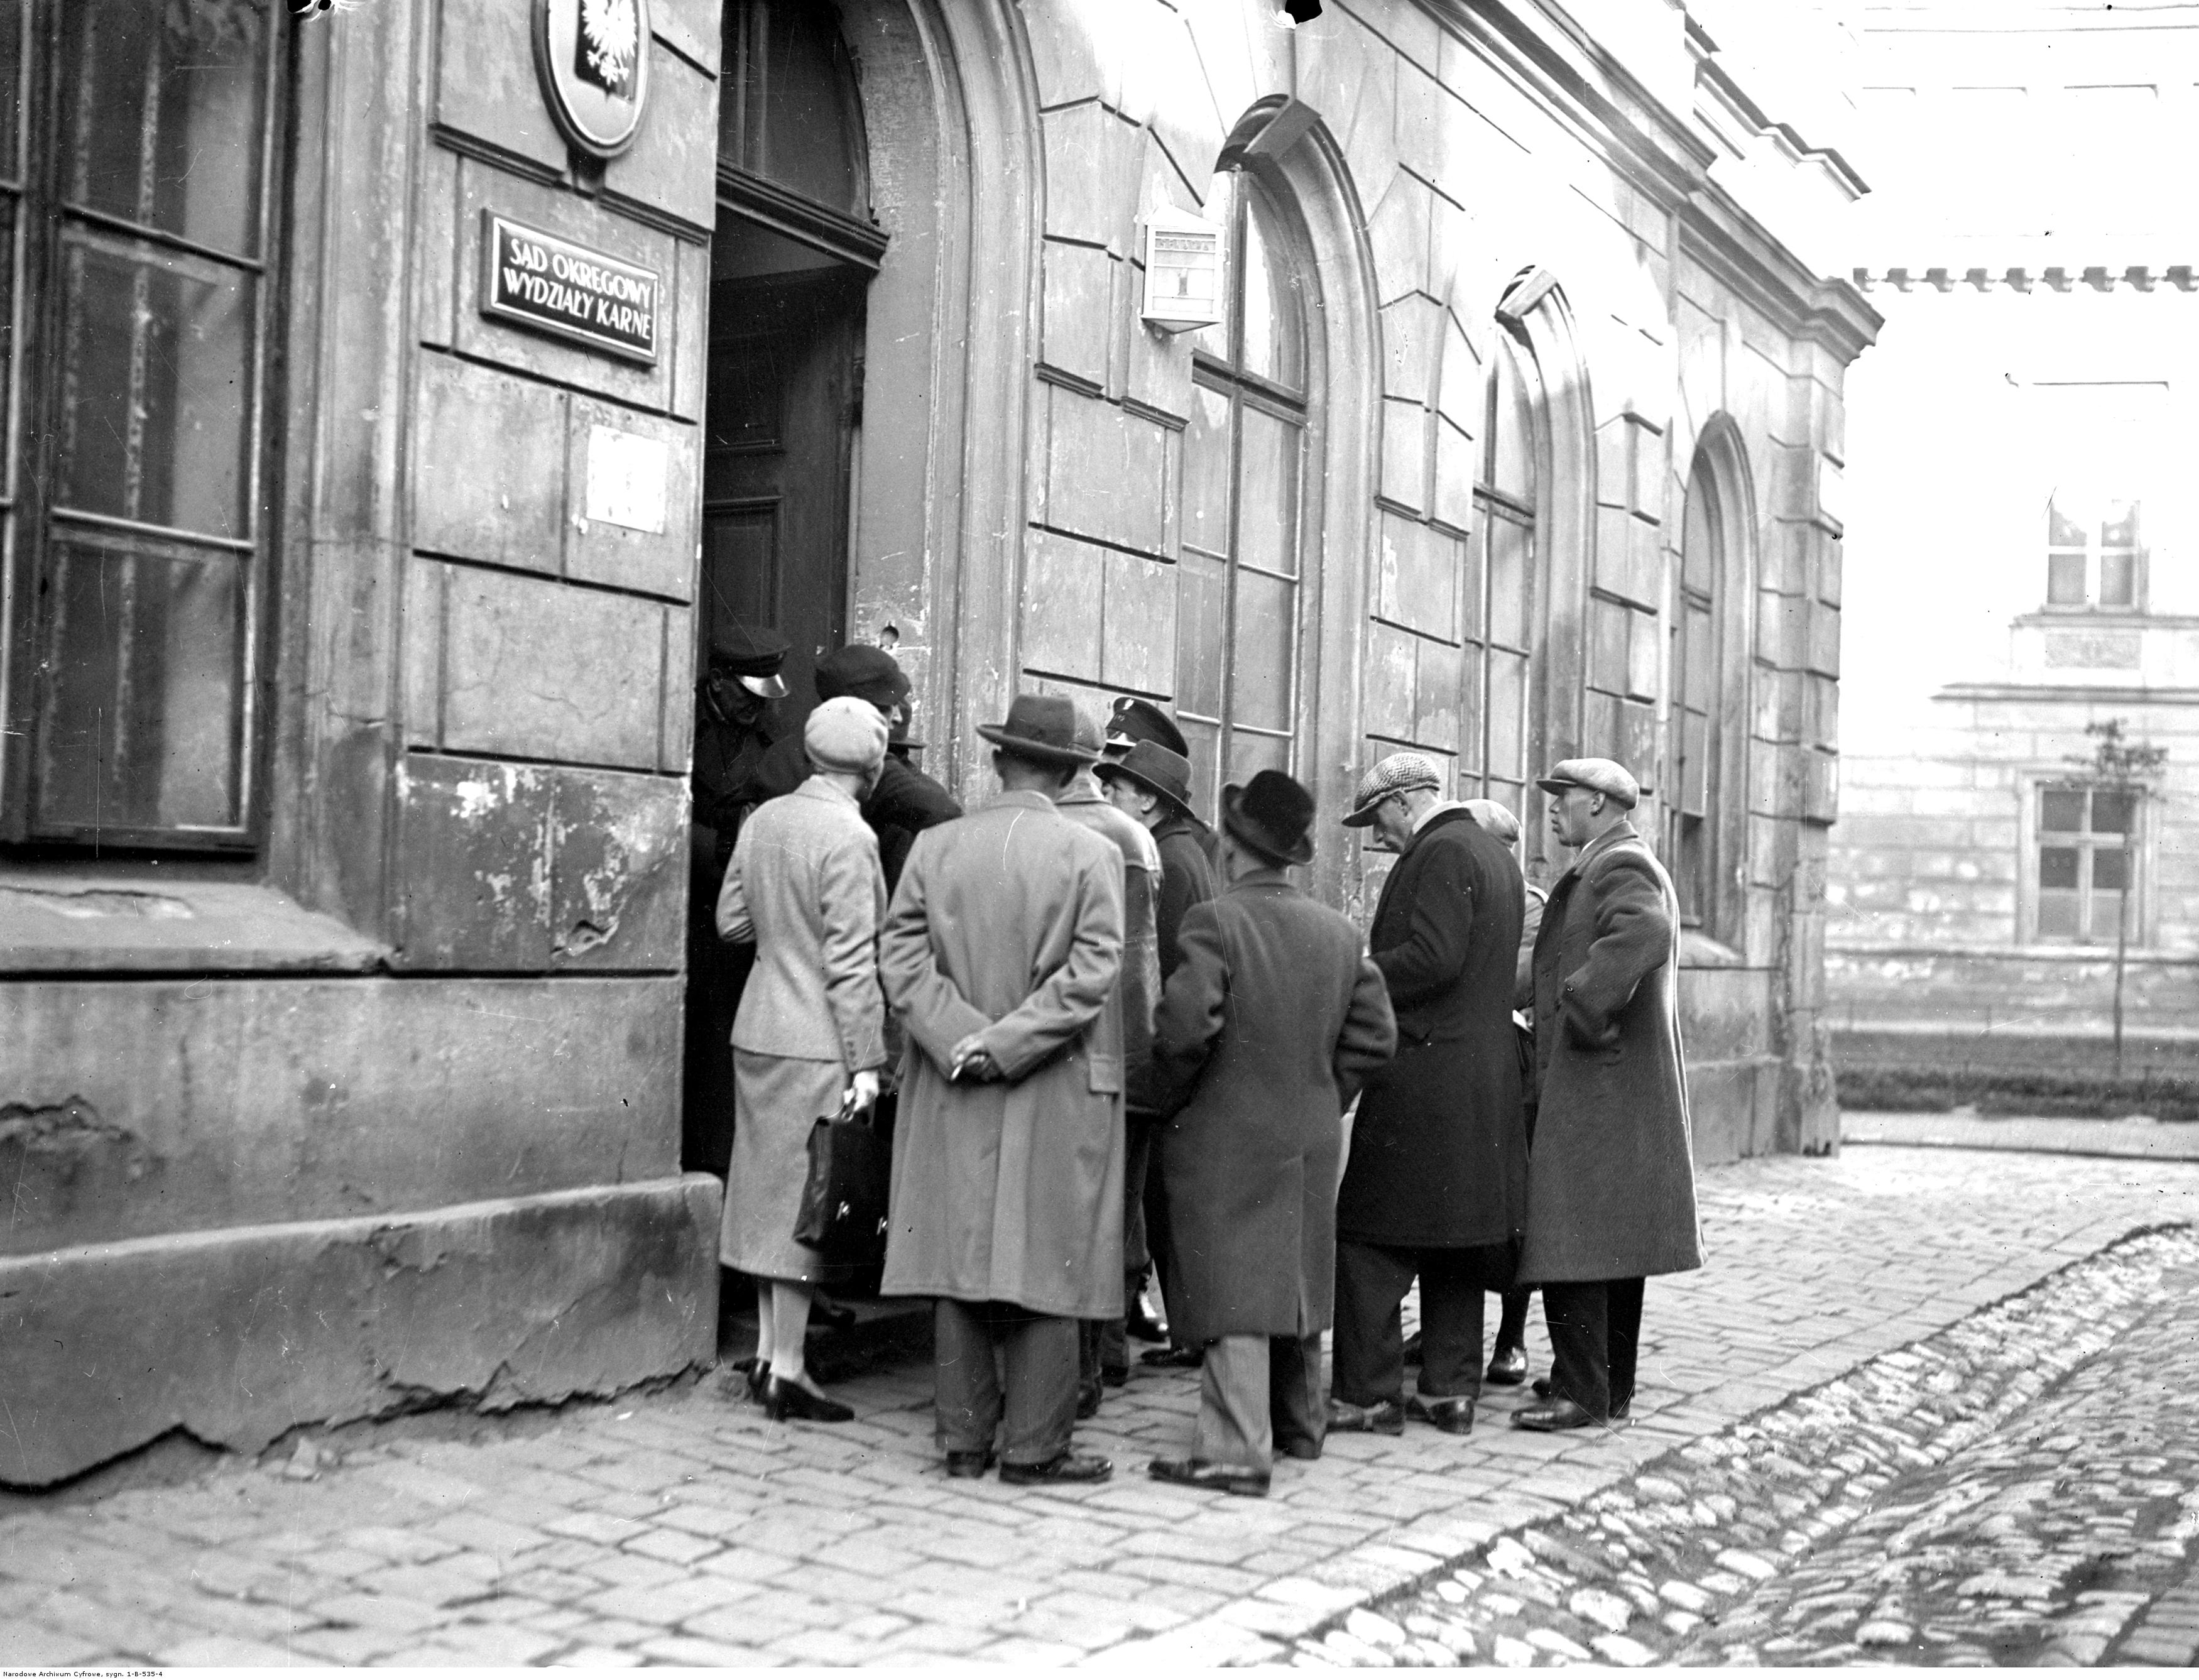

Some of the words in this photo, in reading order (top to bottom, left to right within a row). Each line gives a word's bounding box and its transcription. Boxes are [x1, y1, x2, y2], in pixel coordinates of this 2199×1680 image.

[503, 267, 594, 319] WYDZIAŁY
[596, 298, 652, 340] KARNE
[510, 238, 548, 271] SĄD
[553, 254, 651, 308] OKRĘGOWY
